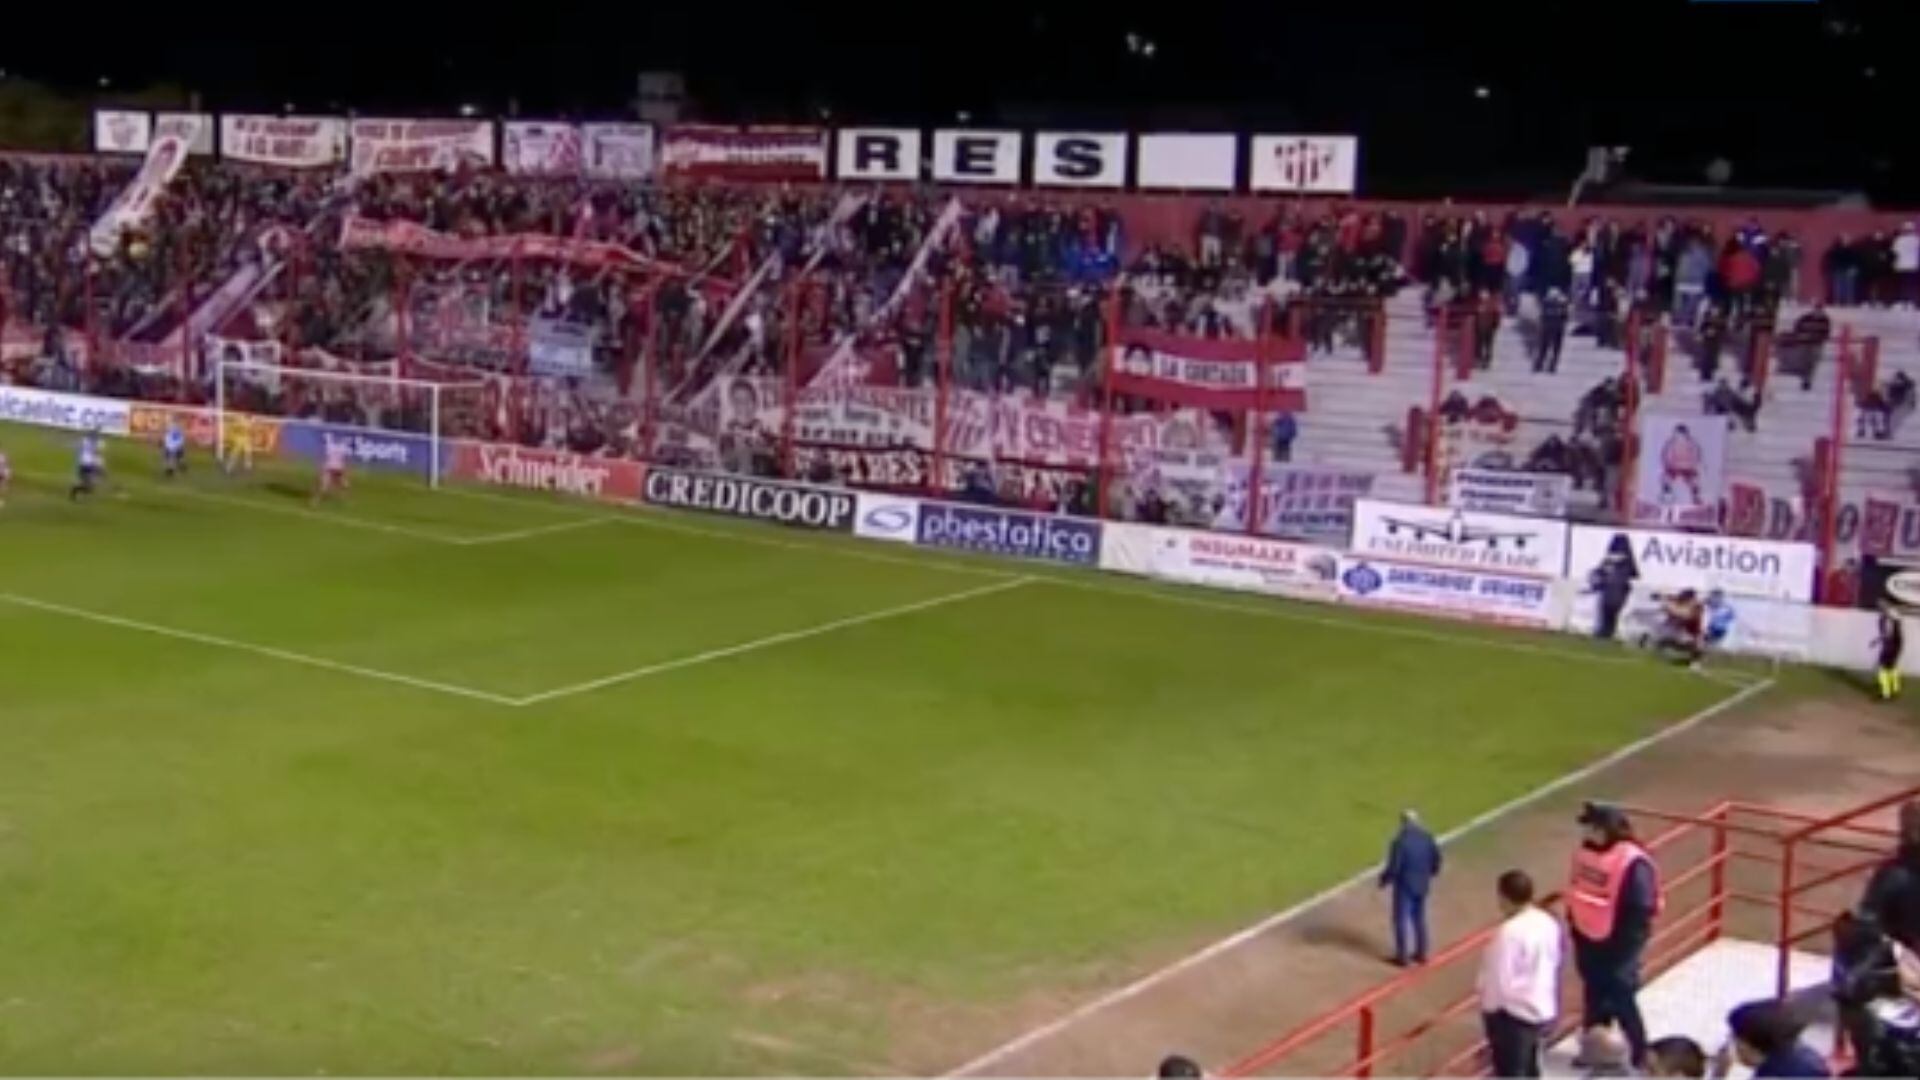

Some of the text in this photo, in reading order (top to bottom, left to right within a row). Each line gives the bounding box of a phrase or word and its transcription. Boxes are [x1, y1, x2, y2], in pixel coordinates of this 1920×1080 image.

[855, 134, 1104, 179] R E S
[478, 445, 611, 496] Schneider
[647, 471, 850, 527] CREDICOOP
[1642, 537, 1781, 574] Aviation
